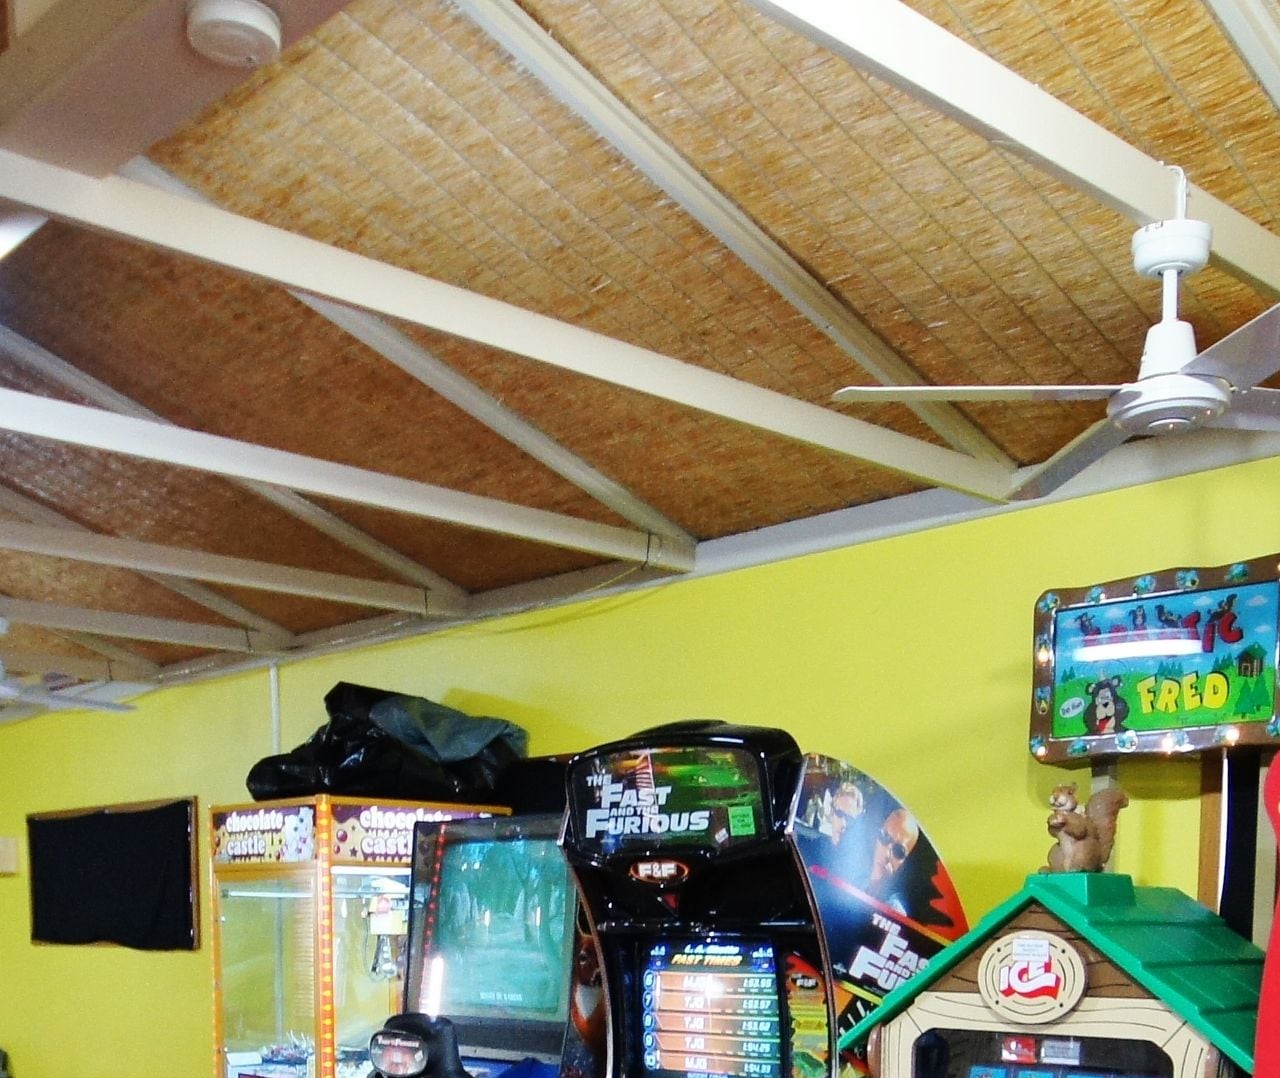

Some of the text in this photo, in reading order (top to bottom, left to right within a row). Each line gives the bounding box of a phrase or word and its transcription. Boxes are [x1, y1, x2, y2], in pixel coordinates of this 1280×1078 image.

[1137, 670, 1229, 714] FRED
[586, 774, 612, 787] THE
[601, 783, 672, 808] FAST
[226, 809, 284, 832] chocolate
[609, 805, 658, 817] AND THE
[586, 809, 711, 838] FURIOUS
[226, 837, 266, 856] castle
[361, 832, 413, 856] castl
[637, 862, 677, 878] F&F
[872, 912, 901, 935] THE
